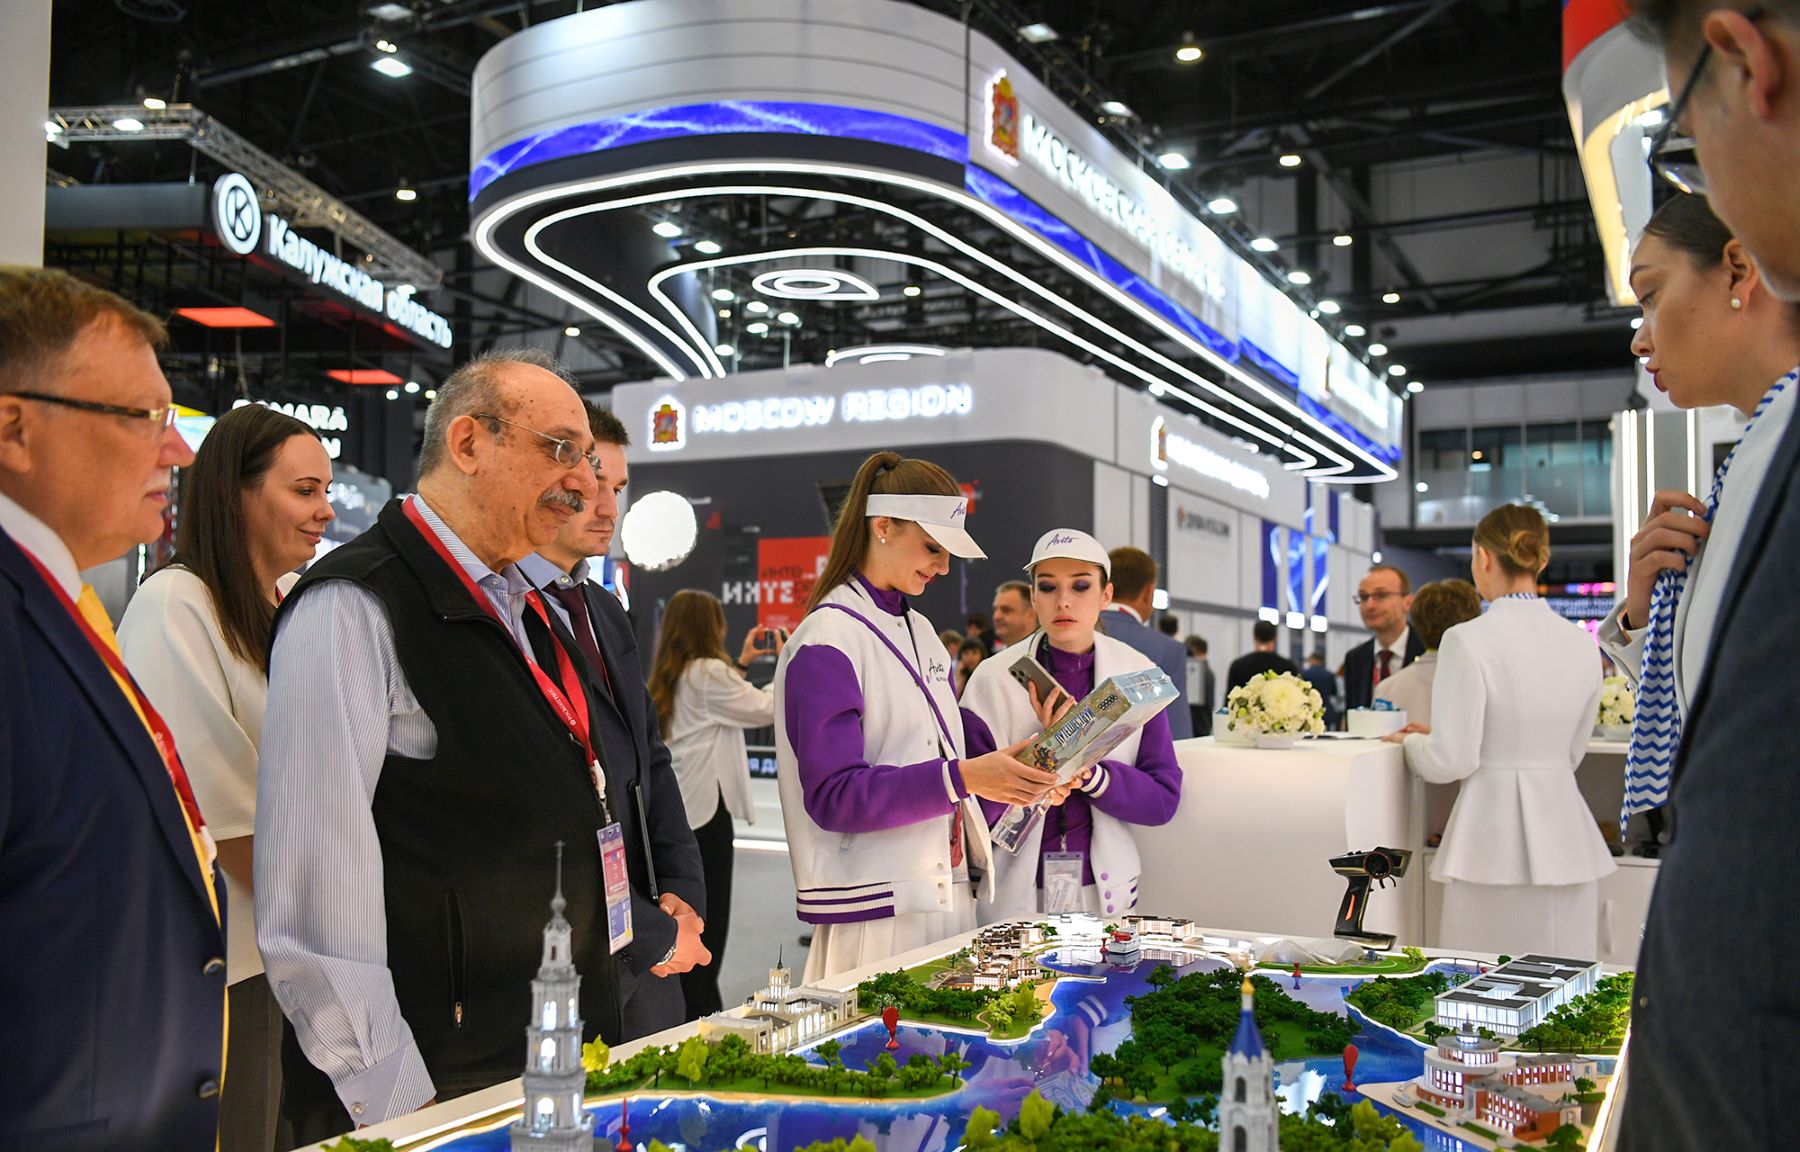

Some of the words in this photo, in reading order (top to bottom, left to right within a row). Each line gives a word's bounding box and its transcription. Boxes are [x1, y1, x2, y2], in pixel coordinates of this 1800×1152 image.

[268, 213, 384, 313] Калужская
[387, 285, 453, 349] область
[692, 396, 835, 433] MOSCOW
[842, 384, 973, 422] REGION
[1045, 533, 1081, 551] Avito
